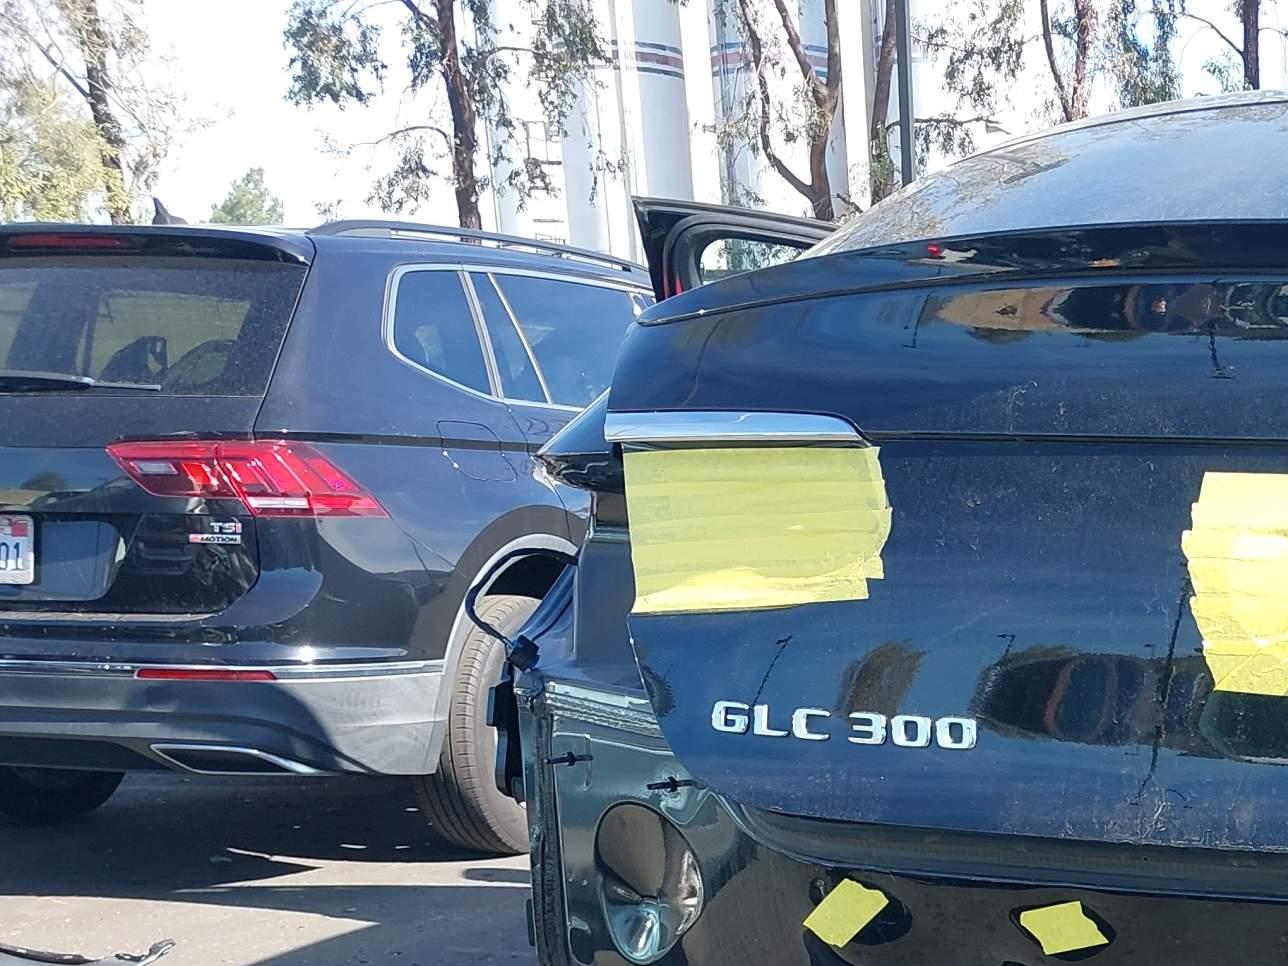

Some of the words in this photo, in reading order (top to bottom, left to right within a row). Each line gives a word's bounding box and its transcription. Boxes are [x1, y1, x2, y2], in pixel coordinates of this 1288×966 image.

[210, 522, 241, 533] TSI
[711, 700, 830, 740] GLC
[847, 711, 977, 749] 300
